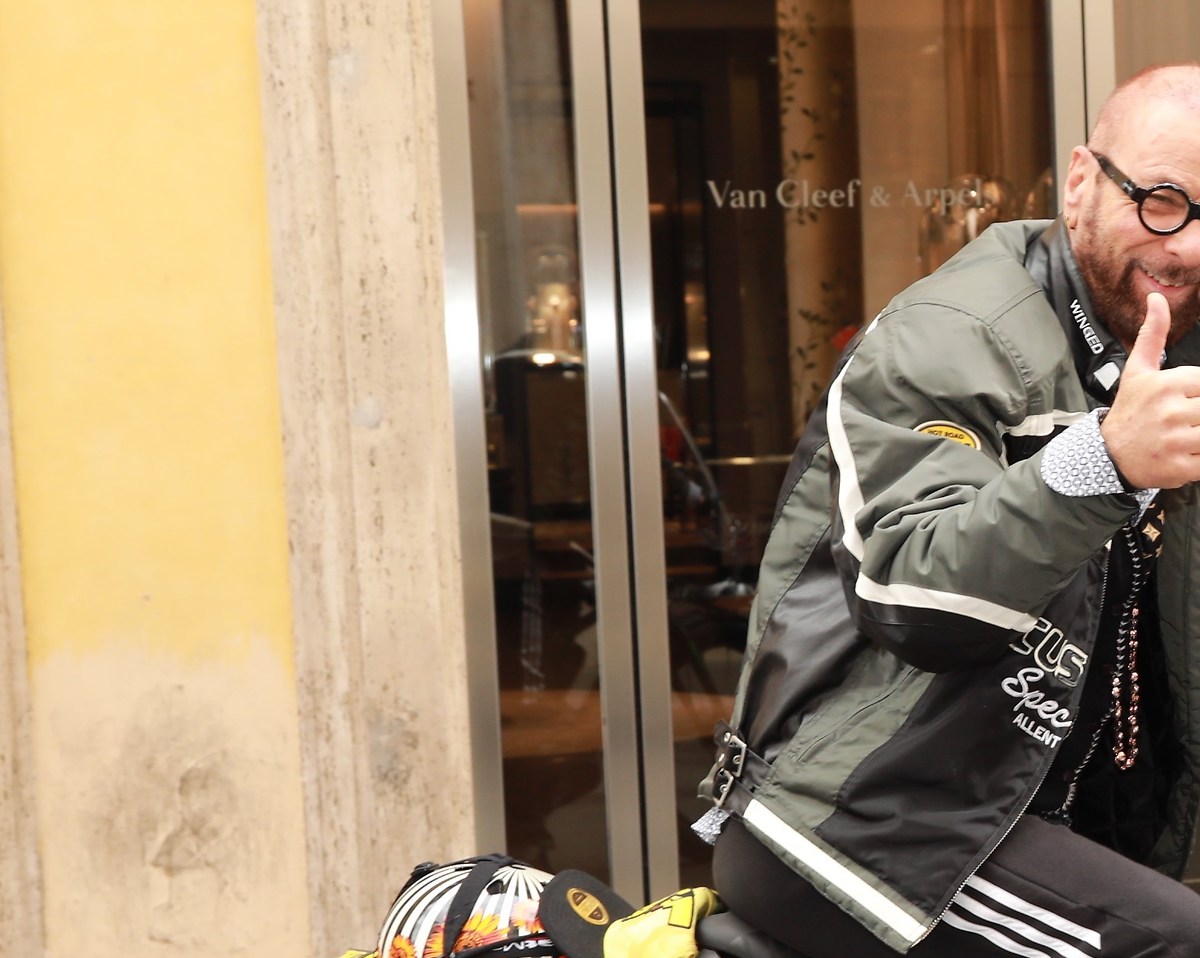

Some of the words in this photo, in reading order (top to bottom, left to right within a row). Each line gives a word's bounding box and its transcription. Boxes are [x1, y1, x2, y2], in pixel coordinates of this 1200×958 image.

[707, 180, 766, 209] Van
[776, 178, 861, 208] Cleef
[870, 187, 891, 208] &
[1069, 299, 1105, 355] WINGED
[1001, 667, 1073, 728] Spec
